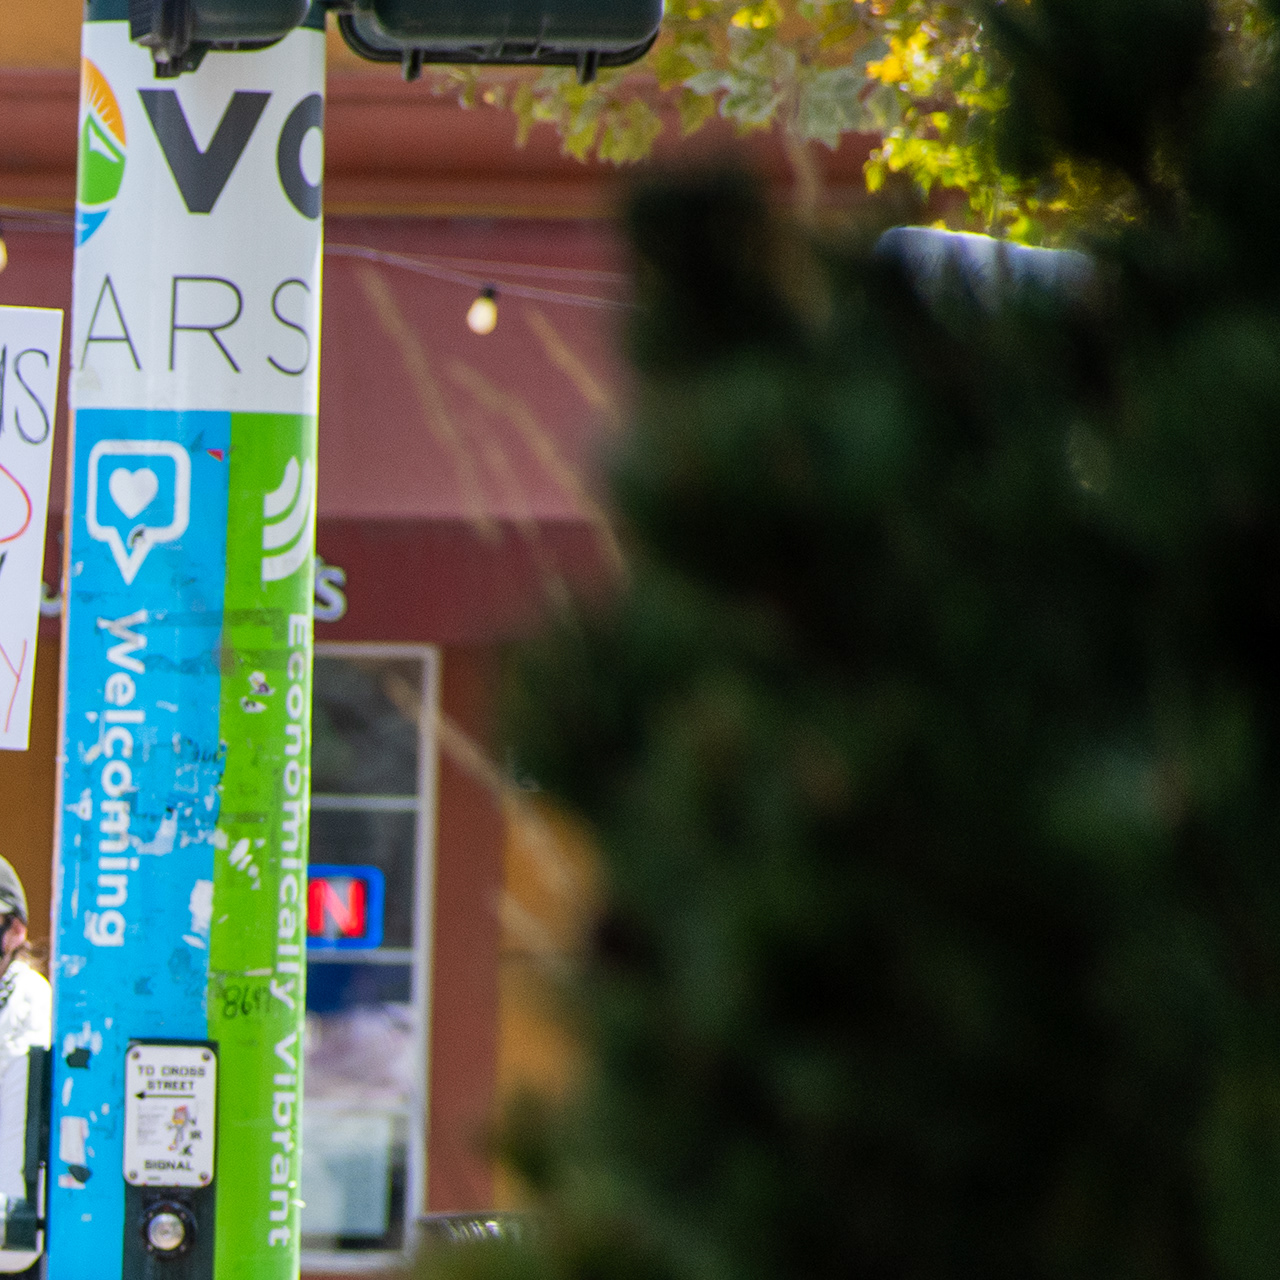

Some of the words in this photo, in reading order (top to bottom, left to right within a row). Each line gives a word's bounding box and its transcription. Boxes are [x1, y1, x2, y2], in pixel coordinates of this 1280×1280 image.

[81, 274, 312, 376] ARS
[84, 609, 148, 947] Welcoming
[270, 613, 308, 1010] Economically
[137, 1065, 156, 1077] TO
[161, 1065, 207, 1077] CROSS
[147, 1080, 195, 1091] STREET
[144, 1159, 193, 1172] SIGNAL
[268, 1031, 299, 1247] Vibrant
